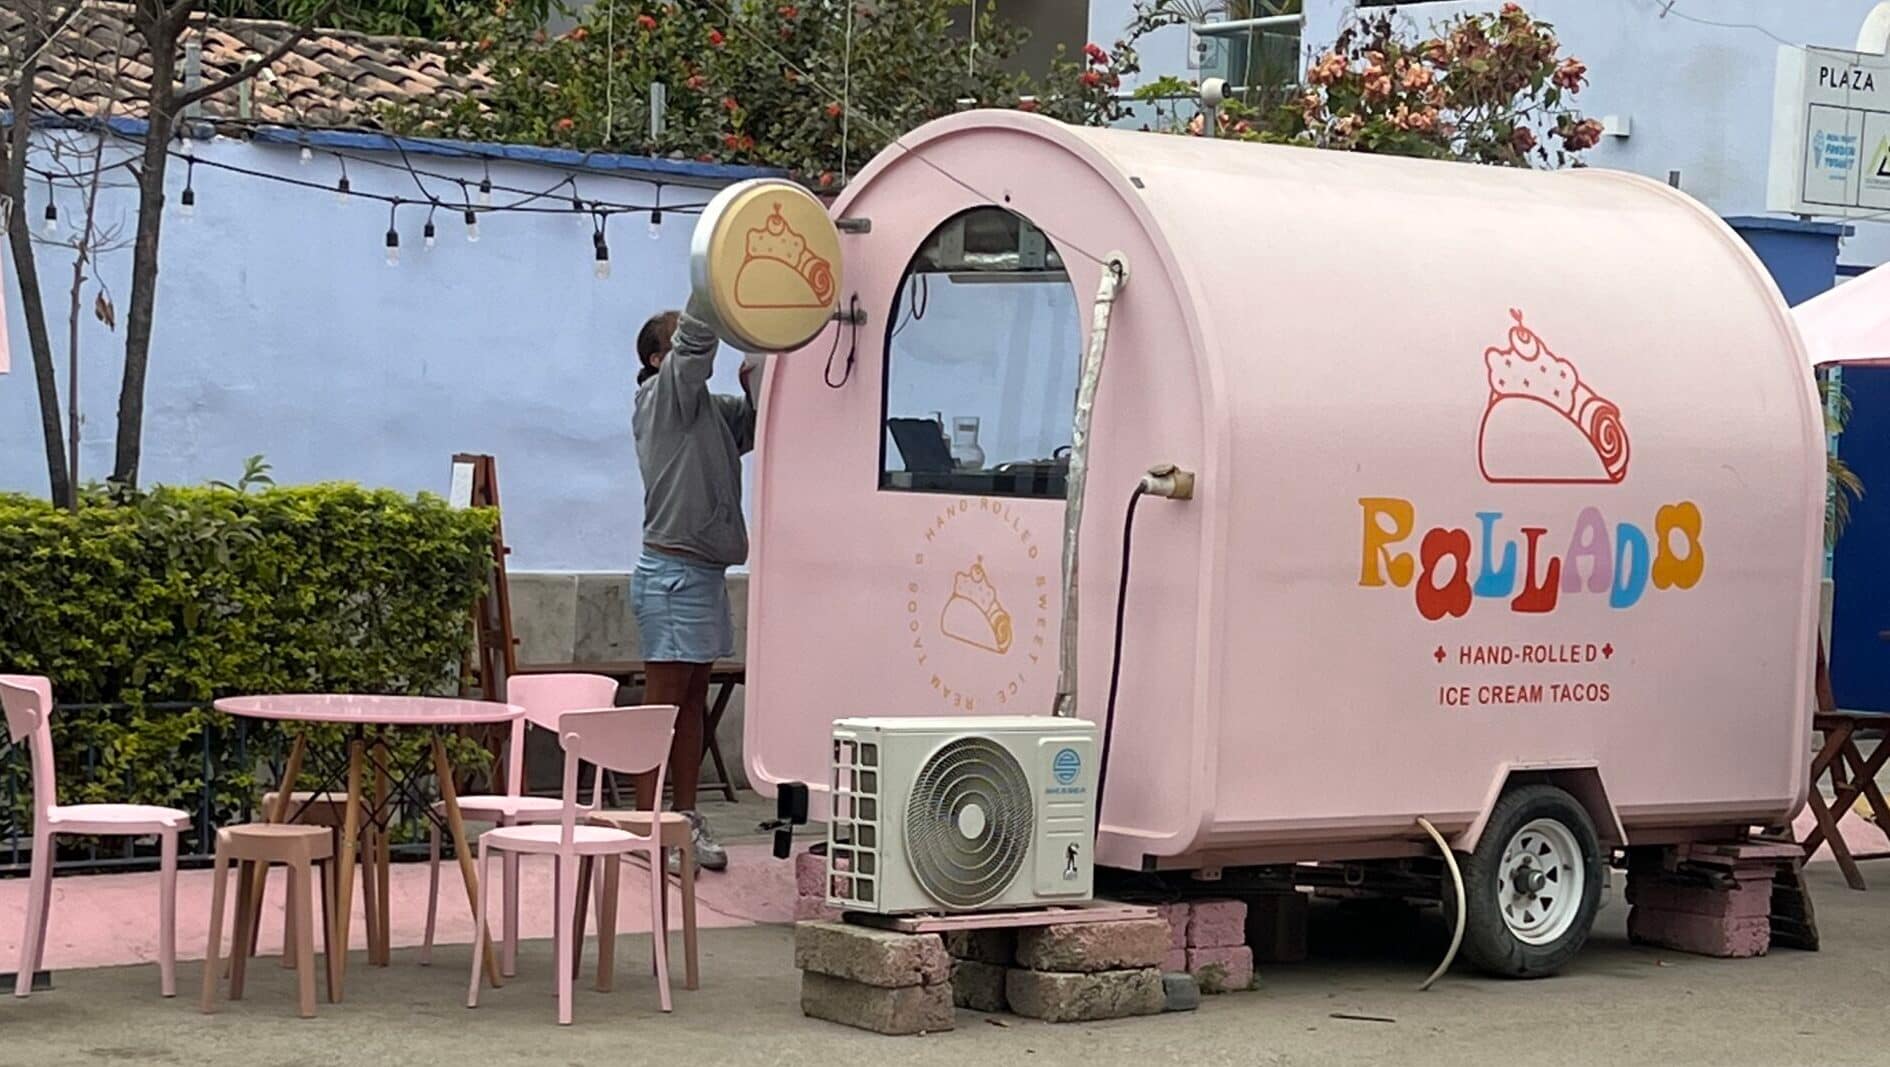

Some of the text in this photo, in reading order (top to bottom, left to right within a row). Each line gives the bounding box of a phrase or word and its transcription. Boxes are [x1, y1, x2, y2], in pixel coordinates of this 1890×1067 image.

[1819, 66, 1875, 92] PLAZA
[1357, 497, 1704, 621] ROLLADO
[1459, 643, 1597, 665] HAND-ROLLED
[1439, 683, 1610, 706] ICE CREAM TACOS
